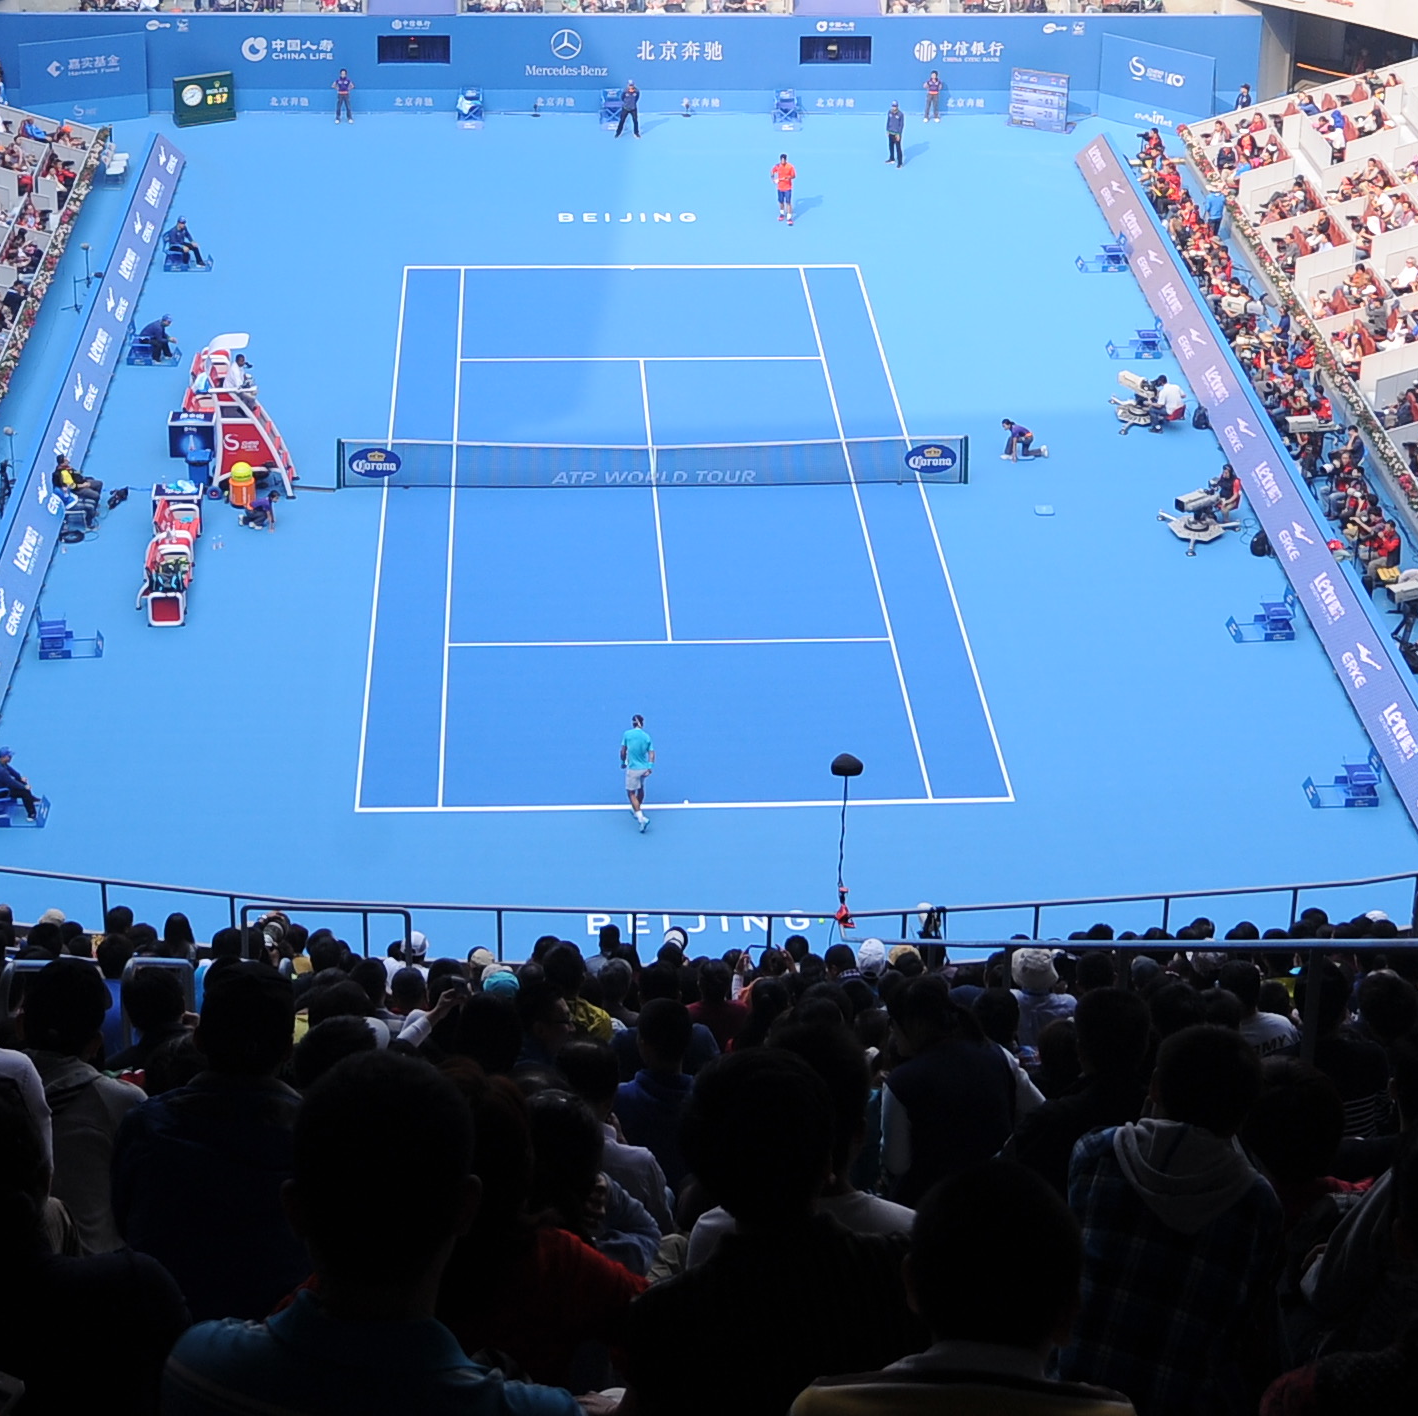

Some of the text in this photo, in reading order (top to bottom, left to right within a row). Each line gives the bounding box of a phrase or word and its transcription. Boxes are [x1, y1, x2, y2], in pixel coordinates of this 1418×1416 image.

[272, 39, 335, 52] 中国人寿
[637, 40, 723, 61] 北京奔驰
[940, 40, 1004, 57] 中信银行
[68, 54, 120, 71] 嘉实基金
[272, 52, 334, 61] CHINA LIFE
[525, 65, 609, 76] Mercedes-Benz
[558, 212, 697, 223] BEIJING
[1136, 256, 1153, 279] ERKE
[1177, 335, 1195, 360] ERKE
[1224, 425, 1244, 453] ERKE
[352, 459, 397, 474] Corona
[908, 455, 953, 469] Corona
[551, 470, 756, 484] ATP WORLD TOUR
[1278, 529, 1300, 562] ERKE
[6, 599, 25, 636] ERKE
[1341, 651, 1367, 689] ERKE
[586, 909, 811, 936] BEIJING
